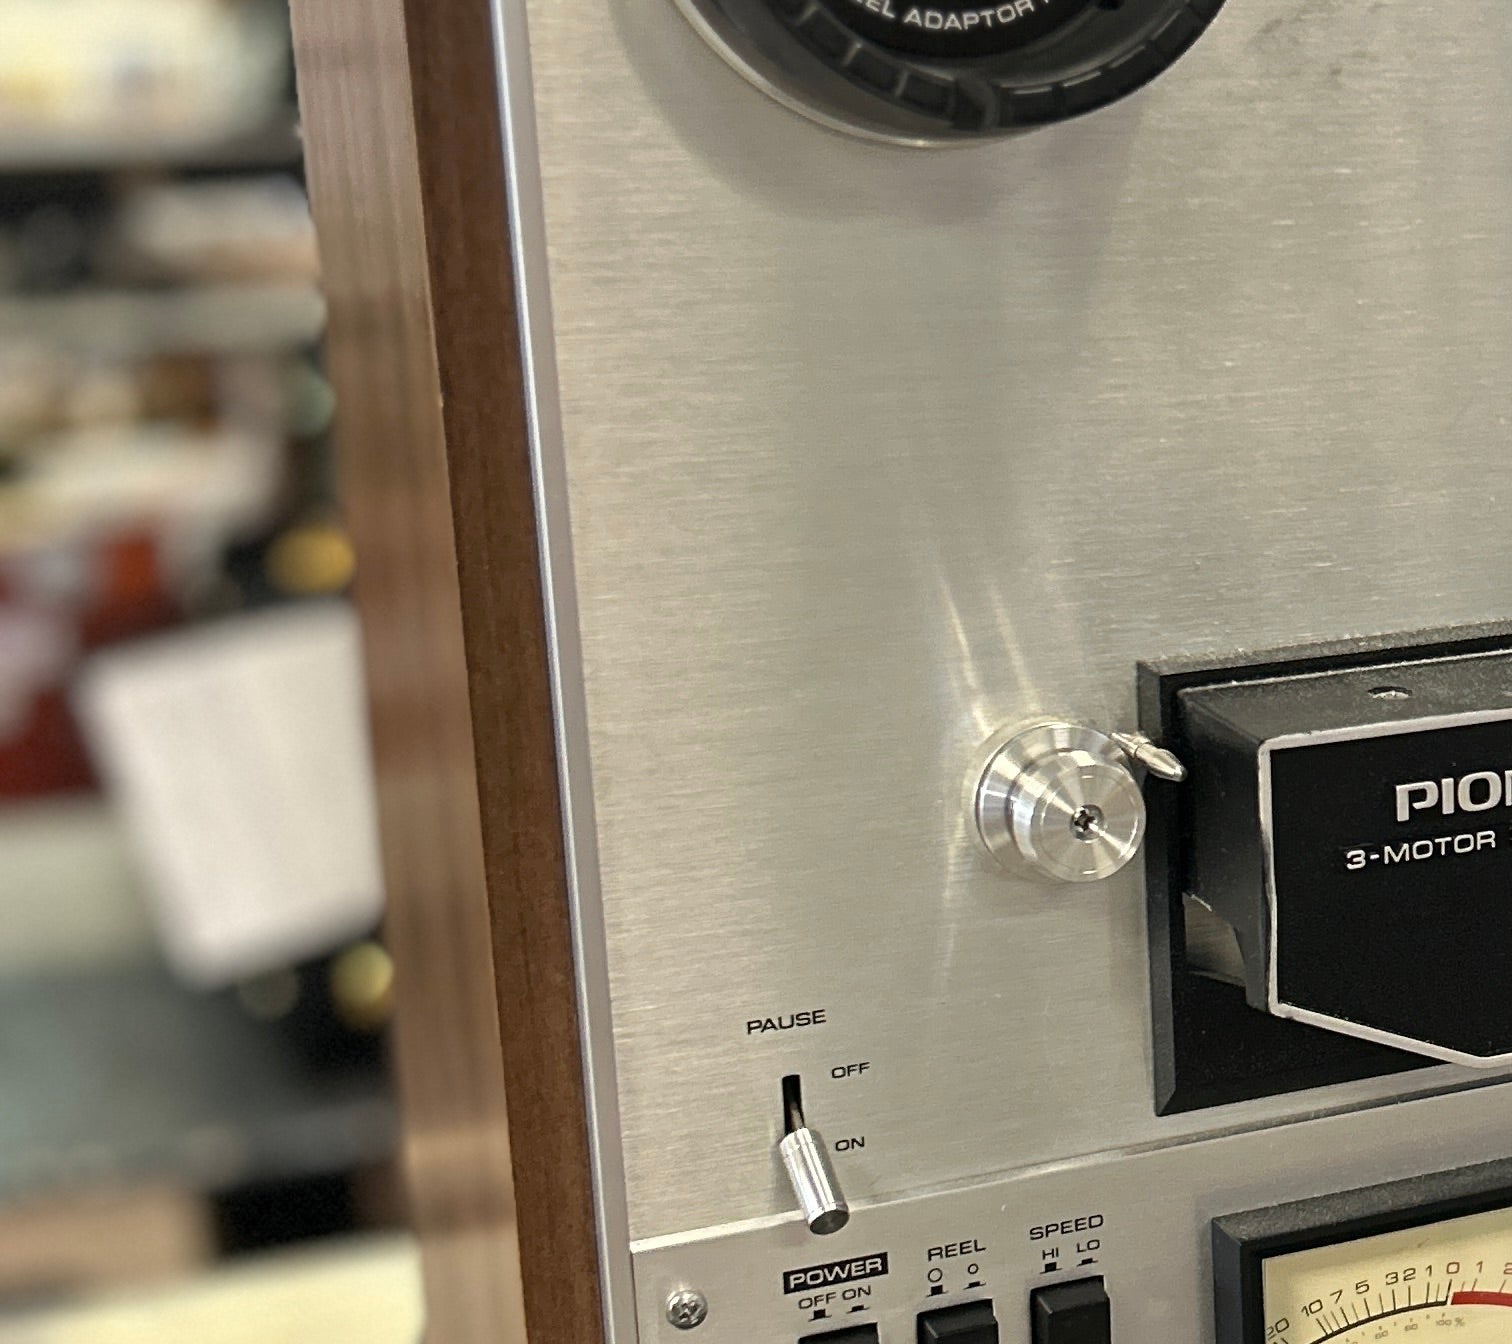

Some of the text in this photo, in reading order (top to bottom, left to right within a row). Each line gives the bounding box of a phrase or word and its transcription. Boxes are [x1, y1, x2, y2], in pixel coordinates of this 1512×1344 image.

[1345, 829, 1497, 871] 3-MOTOR
[746, 1008, 827, 1035] PAUSE
[830, 1061, 871, 1080] OFF
[834, 1136, 866, 1153] ON
[1029, 1214, 1105, 1241] SPEED
[927, 1239, 987, 1261] REEL
[1042, 1238, 1101, 1261] HI LO
[790, 1257, 883, 1289] POWER
[798, 1285, 872, 1310] OFF ON
[1301, 1299, 1324, 1317] 10
[1330, 1289, 1343, 1305] 7
[1355, 1279, 1370, 1295] 5
[1385, 1271, 1399, 1286] 3
[1403, 1267, 1416, 1282] 2
[1425, 1265, 1433, 1277] 1
[1446, 1262, 1460, 1275] 0
[1476, 1260, 1484, 1274] 1
